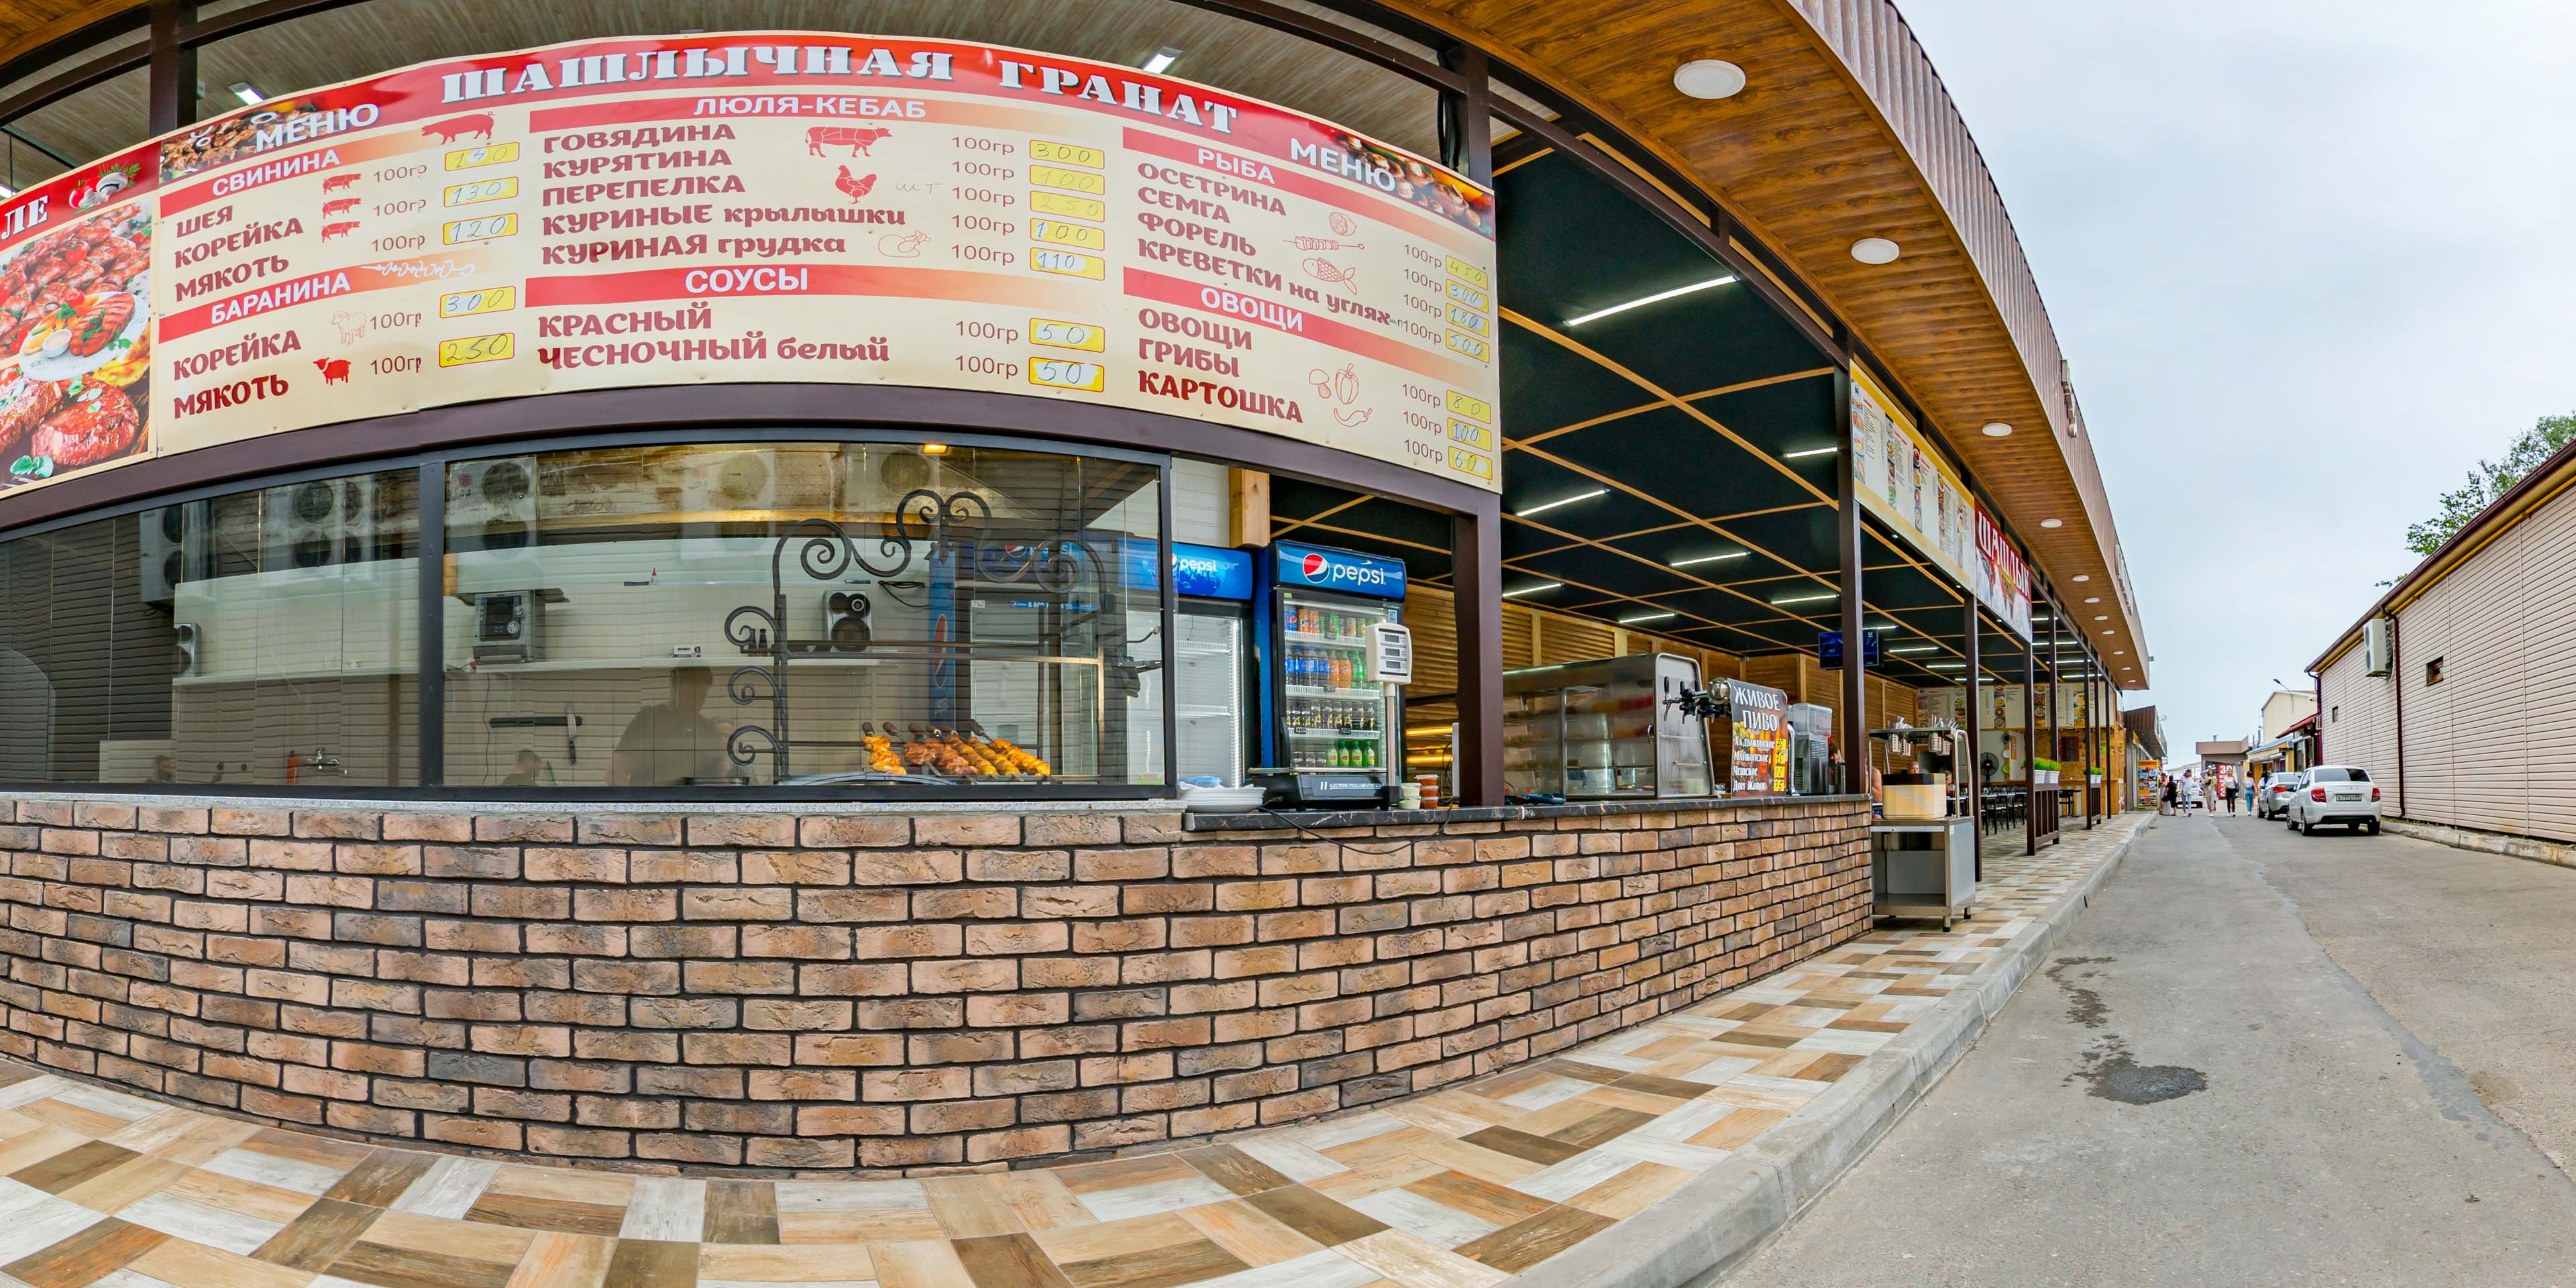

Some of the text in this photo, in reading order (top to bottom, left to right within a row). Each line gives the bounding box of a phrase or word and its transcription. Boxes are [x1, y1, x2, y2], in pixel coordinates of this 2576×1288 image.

[441, 44, 1238, 135] ШАШЛЫЧНАЯ ГРАНАТ
[694, 96, 926, 118] ЛЮЛЯ-КЕБАБ
[256, 103, 380, 153] МЕНЮ
[543, 123, 737, 154] ГОВЯДИНА
[455, 145, 508, 166] 140
[952, 136, 1015, 156] 100гр
[1036, 143, 1091, 163] 300
[213, 149, 341, 197] СВИНИНА
[372, 164, 428, 184] 100гр
[543, 149, 733, 179] КУРЯТИНА
[952, 161, 1015, 180] 100гр
[1197, 148, 1275, 184] РЫБА
[1291, 138, 1397, 193] МЕНЮ
[452, 181, 502, 204] 130
[543, 174, 745, 207] ПЕРЕПЕЛКА
[1040, 170, 1095, 190] 100
[1138, 162, 1287, 217] ОСЕТРИНА
[372, 199, 427, 218] 100гр
[952, 186, 1015, 207] 100гр
[1040, 195, 1099, 216] 250
[1138, 186, 1231, 224] СЕМГА
[1, 195, 49, 239] ЛЕ
[176, 205, 233, 238] ШЕЯ
[451, 215, 505, 242] 120
[543, 203, 906, 235] КУРИНЫЕ крылышки
[952, 215, 1015, 235] 100гр
[174, 217, 304, 269] КОРЕЙКА
[371, 235, 426, 253] 100гр
[1036, 222, 1089, 242] 100
[1138, 212, 1256, 256] ФОРЕЛЬ
[542, 234, 846, 266] КУРИНАЯ грудка
[951, 244, 1015, 265] 100гр
[1037, 252, 1075, 270] 110
[1403, 244, 1442, 270] 100гр
[174, 254, 290, 303] МЯКОТЬ
[685, 268, 808, 294] СОУСЫ
[1138, 237, 1391, 326] КРЕВЕТКИ на углях
[1403, 268, 1442, 294] 100гр
[211, 272, 351, 325] БАРАНИНА
[445, 288, 504, 313] 300
[1201, 287, 1303, 333] ОВОЩИ
[1403, 294, 1442, 319] 100гр
[370, 311, 422, 331] 100гр
[537, 301, 712, 337] КРАСНЫЙ
[956, 321, 1019, 343] 100гр
[1138, 308, 1253, 350] ОВОЩИ
[1403, 319, 1442, 345] 100гр
[445, 332, 509, 362] 250
[1040, 323, 1085, 345] 50
[173, 329, 302, 381] КОРЕЙКА
[537, 331, 891, 370] ЧЕСНОЧНЫЙ белый
[1138, 337, 1240, 378] ГРИБЫ
[370, 356, 422, 376] 100гр
[955, 355, 1018, 378] 100гр
[1038, 360, 1083, 385] 50
[173, 374, 290, 420] МЯКОТЬ
[1138, 370, 1304, 423] КАРТОШКА
[1401, 383, 1441, 409] 100гр
[1403, 411, 1442, 436] 100гр
[1404, 439, 1444, 464] 100гр
[1180, 557, 1218, 574] pepsi
[1978, 511, 2031, 602] ШАШЛЫК
[1332, 562, 1385, 586] pepsi
[1733, 686, 1781, 711] ЖИВОЕ
[1742, 710, 1780, 732] ПИВО
